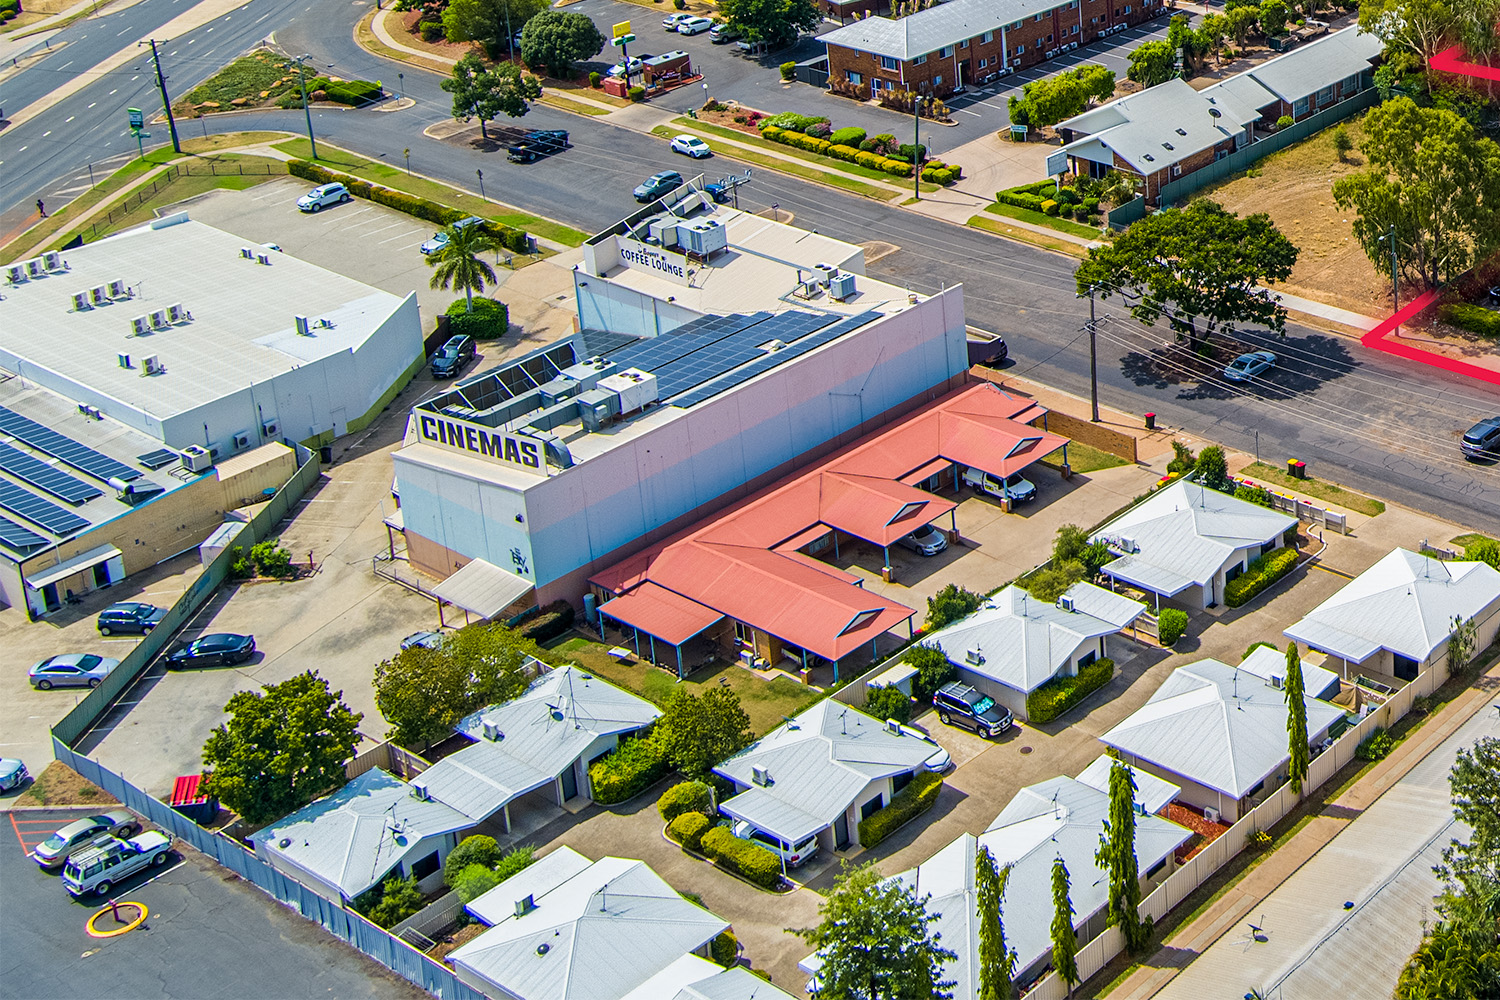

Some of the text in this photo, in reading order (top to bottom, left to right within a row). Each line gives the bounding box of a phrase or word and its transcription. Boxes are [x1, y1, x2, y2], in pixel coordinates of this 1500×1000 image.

[621, 248, 650, 266] COFFEE
[651, 258, 684, 278] LOUNGE
[420, 415, 539, 469] CINEMAS
